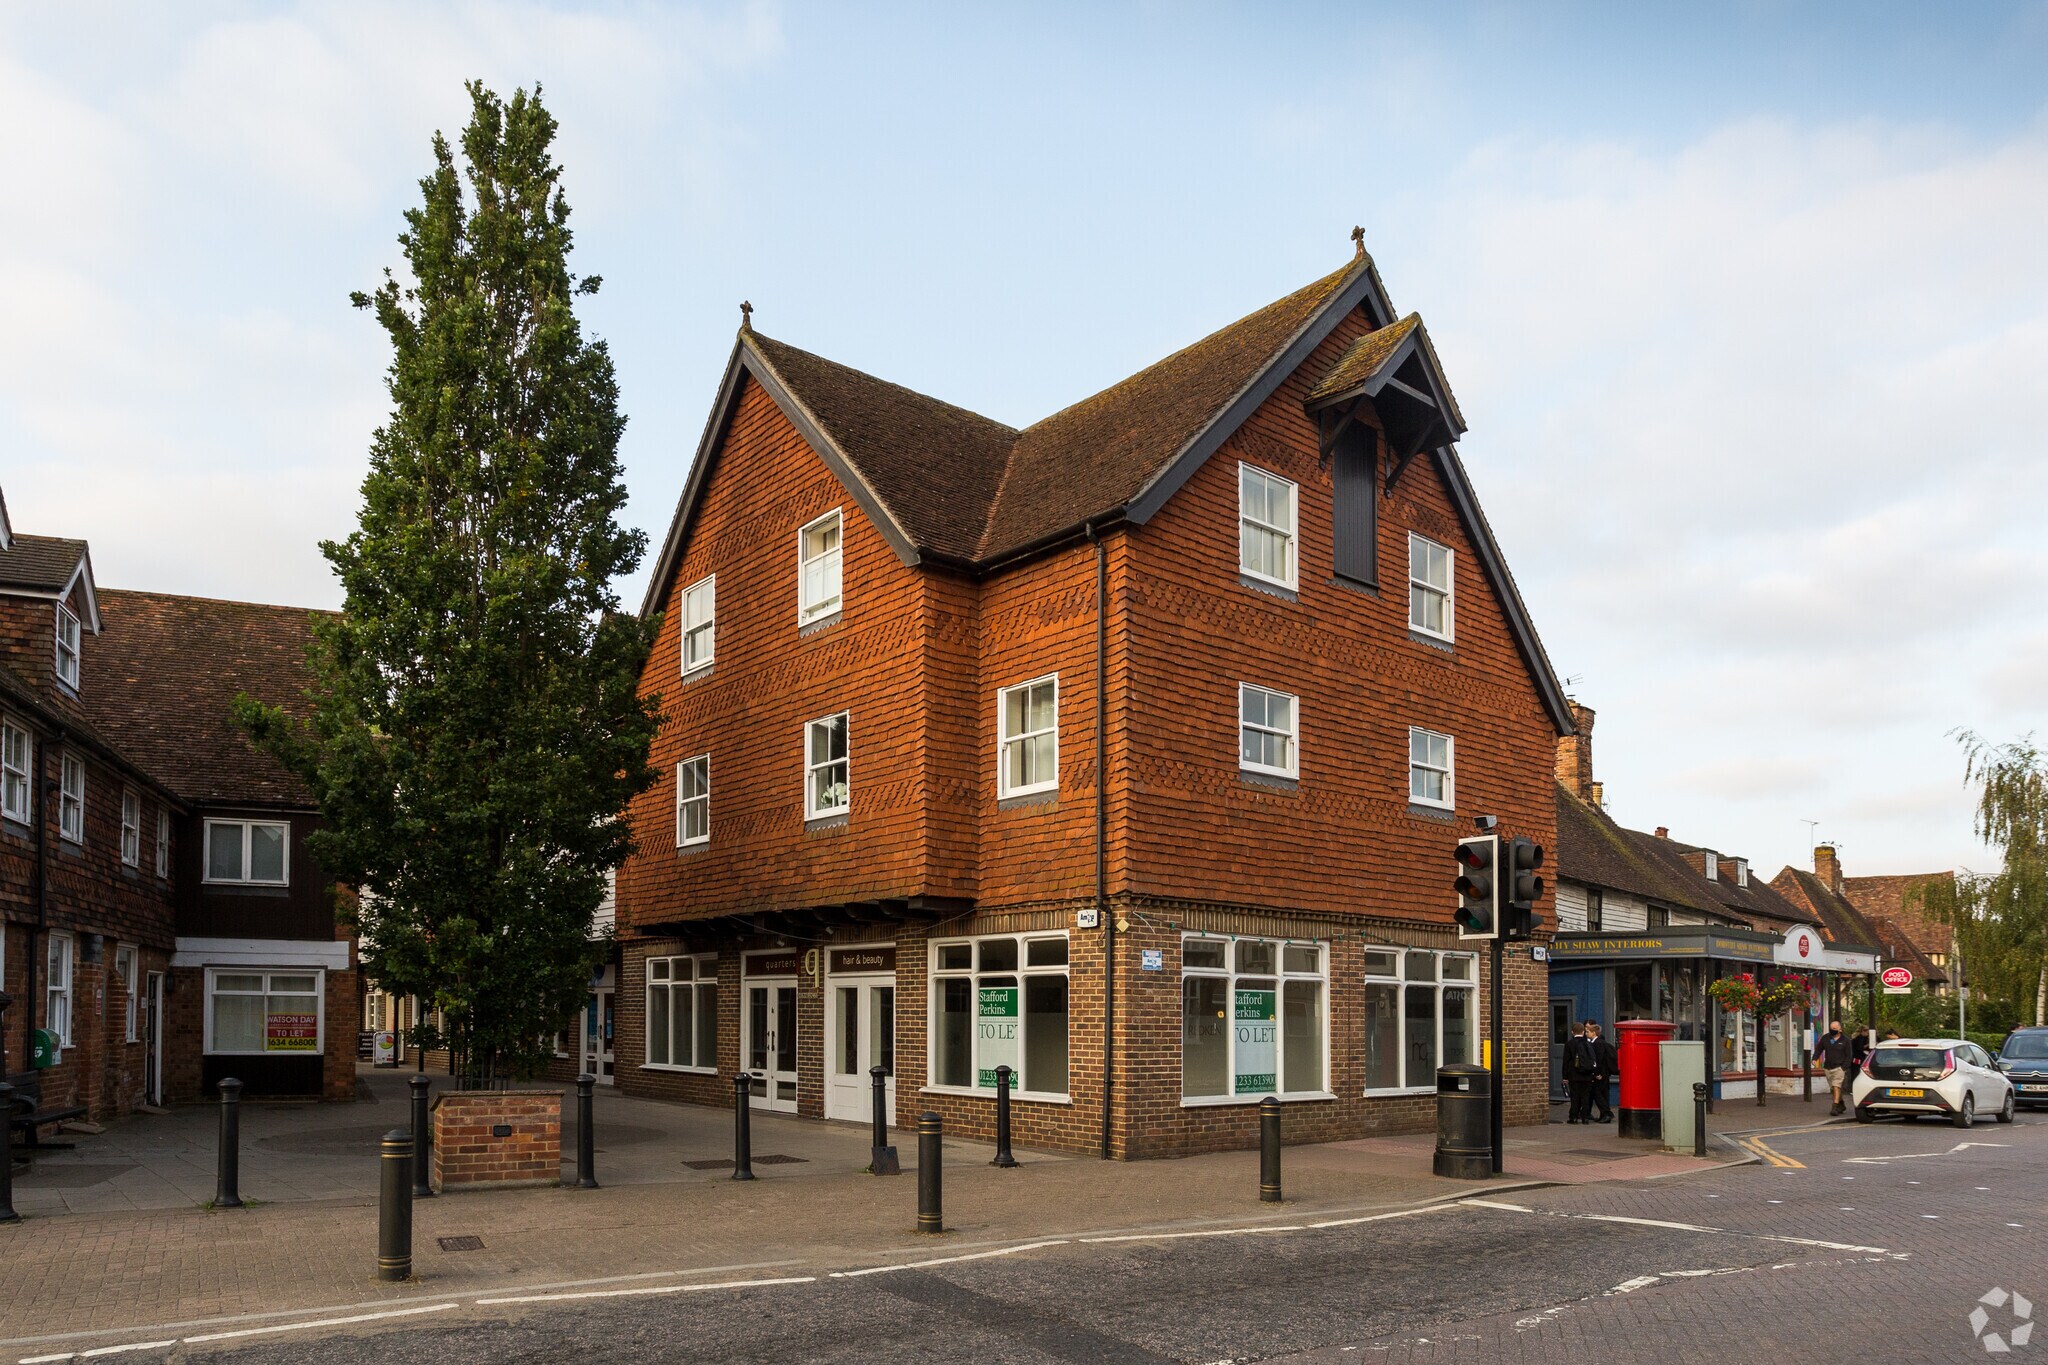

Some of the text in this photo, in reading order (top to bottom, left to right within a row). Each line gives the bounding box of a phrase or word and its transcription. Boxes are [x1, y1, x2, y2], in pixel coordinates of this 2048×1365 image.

[1573, 941, 1600, 949] SHAW
[1604, 940, 1662, 949] INTERIORS
[766, 960, 796, 971] quarters
[843, 954, 884, 966] hair & beauty
[979, 991, 1008, 1002] Stafford
[979, 1004, 1006, 1015] Perkins
[1236, 1007, 1261, 1018] erkins
[979, 1024, 995, 1039] TO
[1236, 1027, 1276, 1043] TO LET
[979, 1071, 997, 1081] 01233
